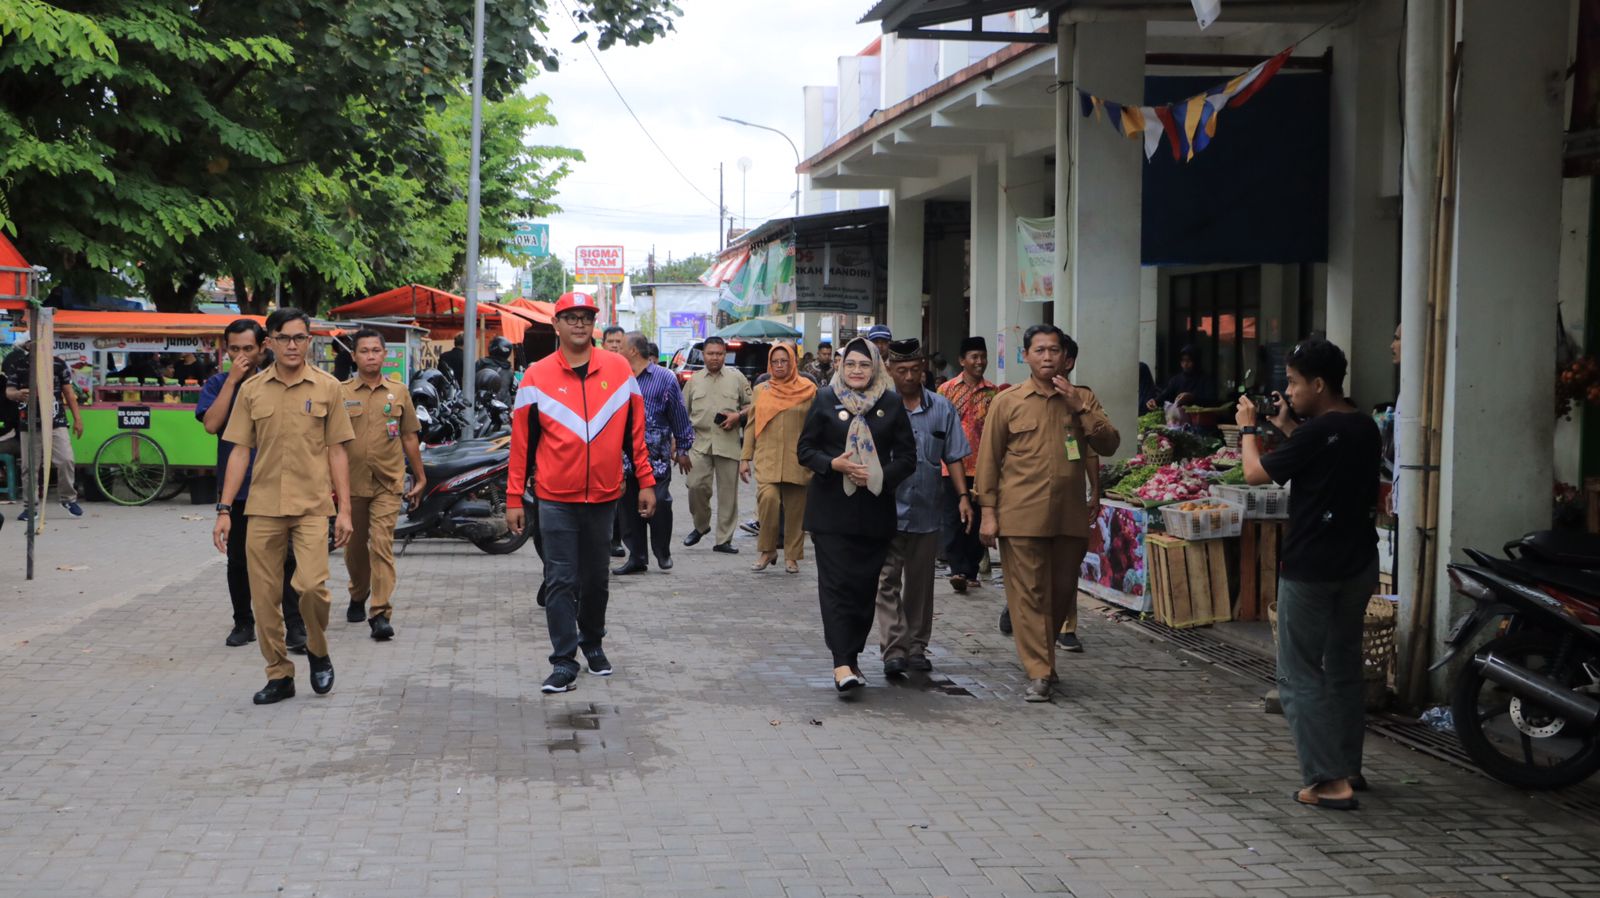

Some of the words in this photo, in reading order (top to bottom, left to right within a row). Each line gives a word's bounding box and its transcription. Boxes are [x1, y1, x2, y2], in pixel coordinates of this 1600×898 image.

[580, 249, 619, 258] SIGMA
[583, 258, 617, 266] FOAM
[53, 341, 86, 350] JUMBO
[123, 416, 145, 426] 5.000
